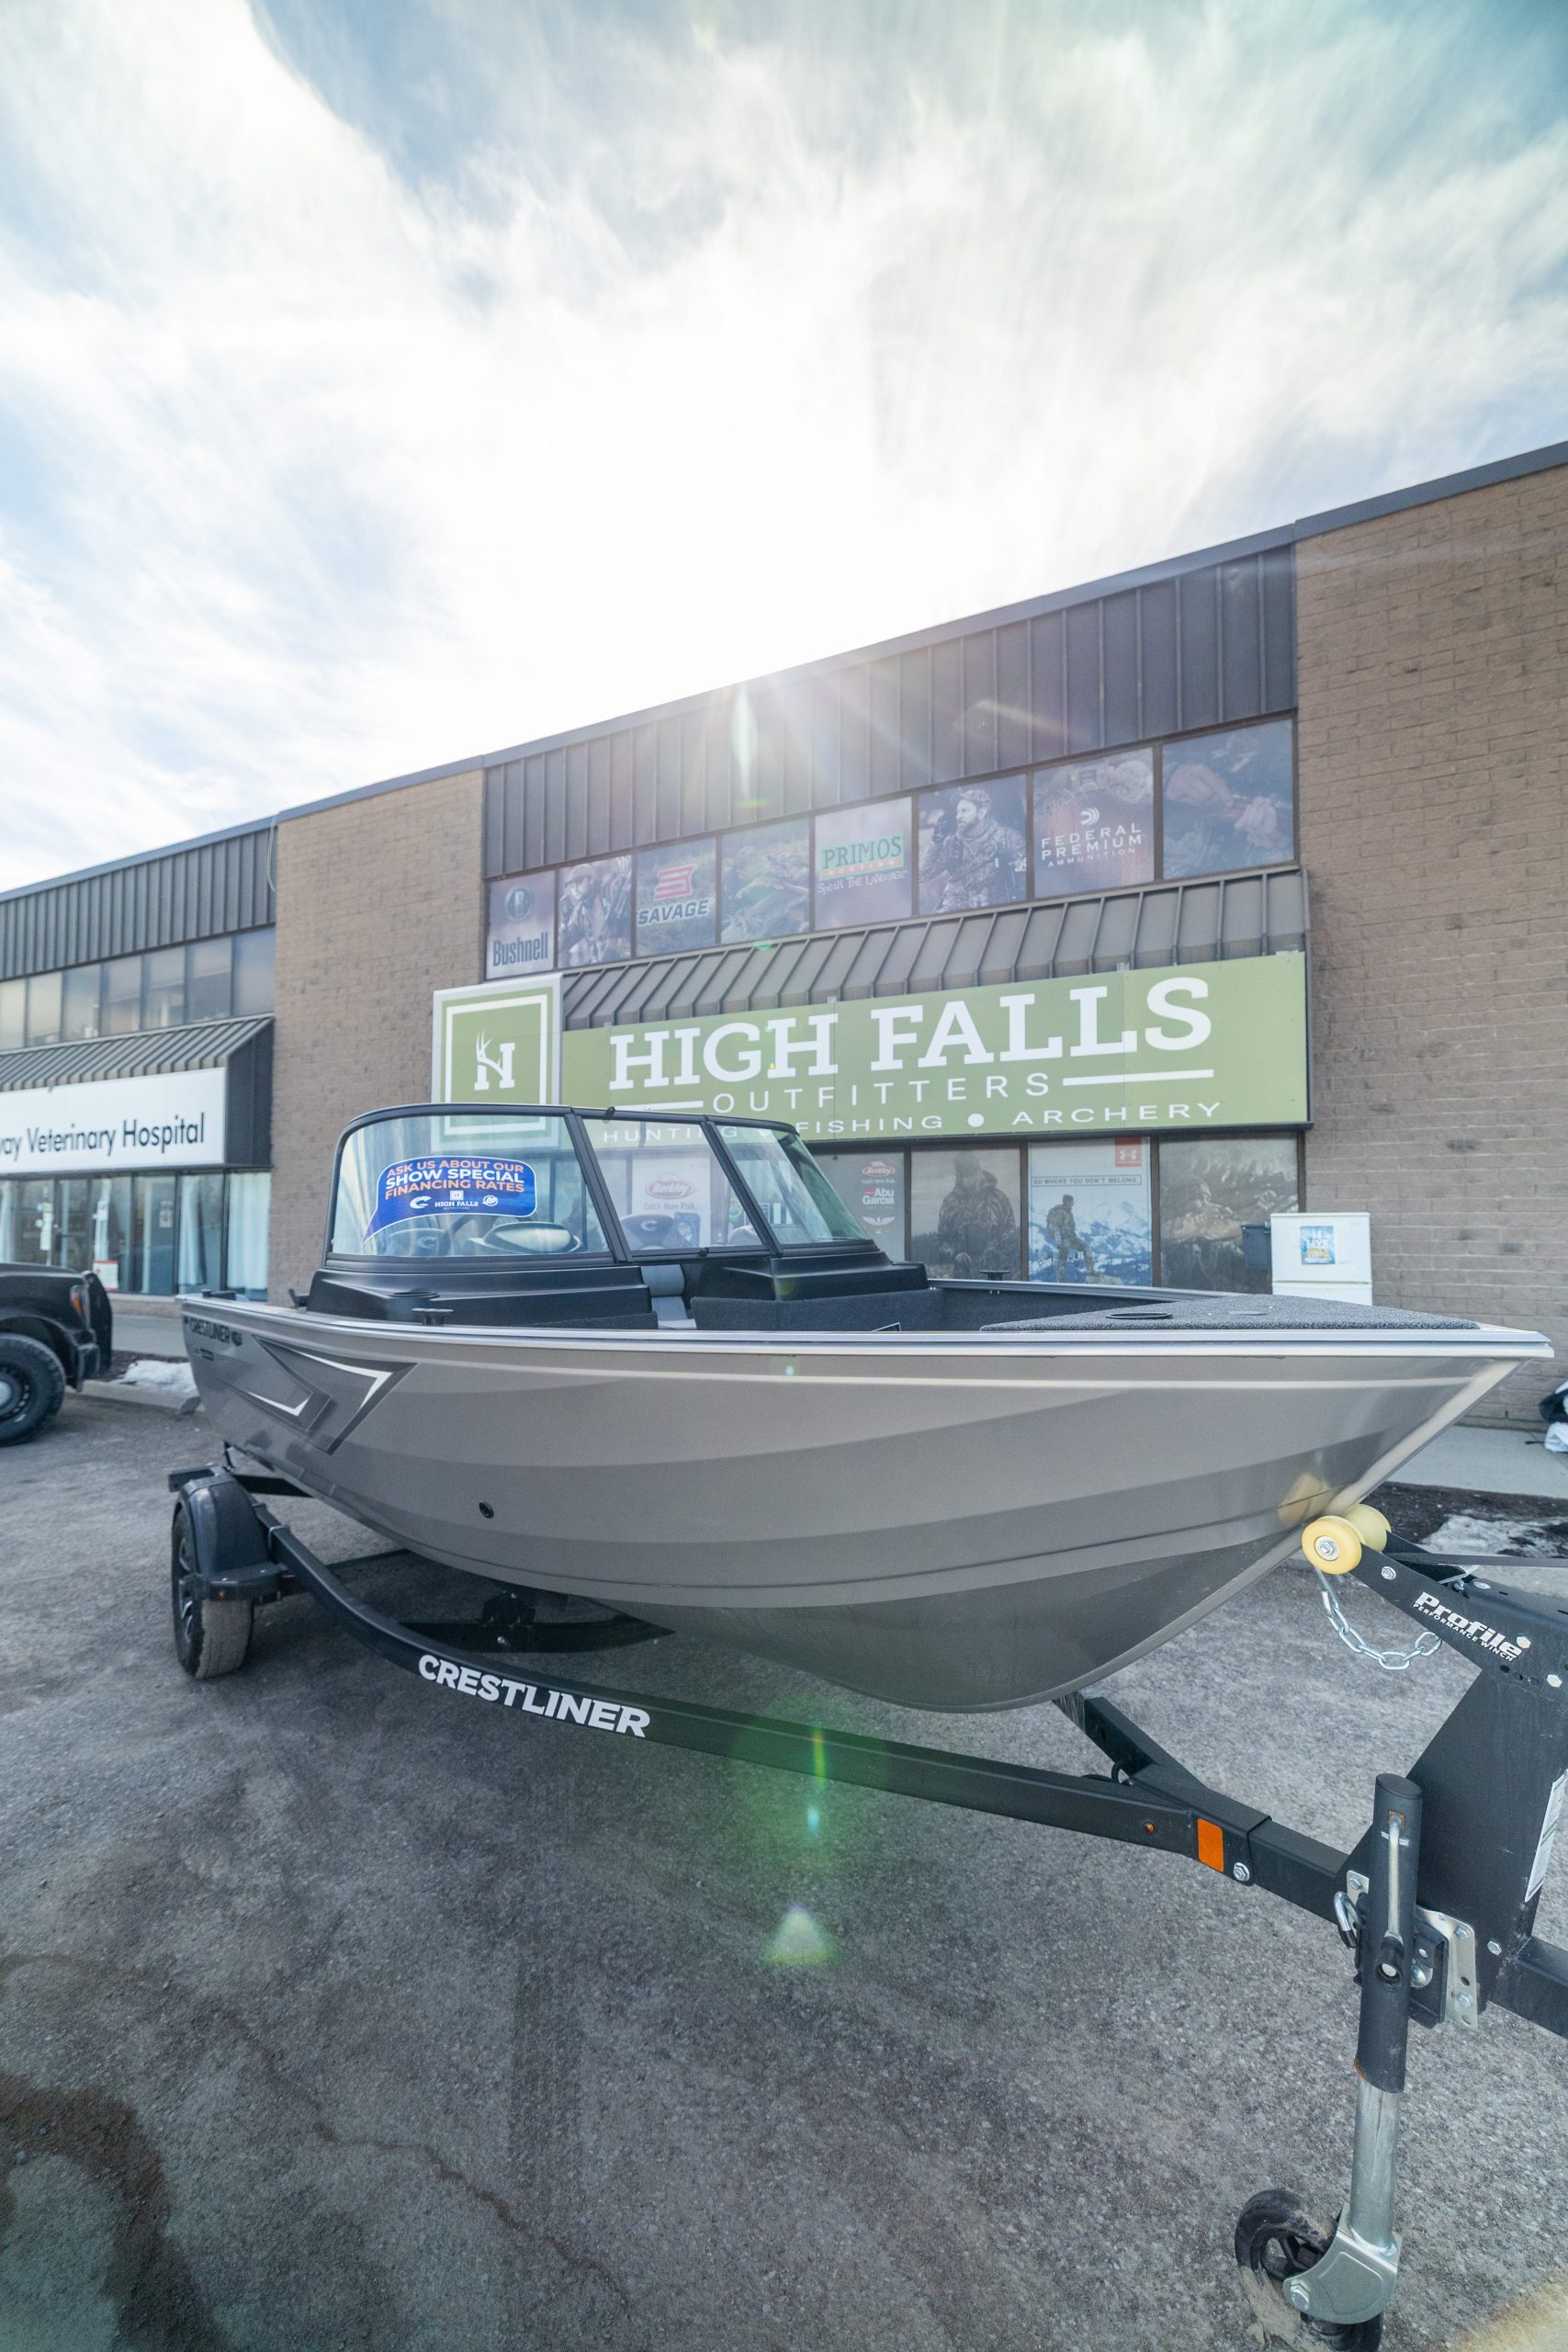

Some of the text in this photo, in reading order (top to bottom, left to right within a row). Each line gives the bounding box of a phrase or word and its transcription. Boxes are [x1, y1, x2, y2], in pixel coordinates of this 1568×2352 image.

[1041, 823, 1142, 849] FEDERAL
[1042, 834, 1142, 860] PREMIUM
[823, 836, 902, 869] PRIMOS
[1048, 848, 1135, 867] AMMUNITION
[637, 899, 709, 925] SAVAGE
[492, 932, 549, 967] Bushnell
[609, 977, 1213, 1090] HIGH FALLS
[713, 1072, 1050, 1114] OUTFITTERS
[795, 1115, 942, 1133] FISHING
[1012, 1102, 1222, 1125] ARCHERY
[0, 1112, 205, 1162] ay Veterinary Hospital
[386, 1160, 525, 1178] ASK US ABOUT OUR
[386, 1169, 525, 1190] SHOW SPECIAL
[385, 1180, 525, 1200] FINANCING RATES
[863, 1195, 895, 1204] Garcia
[874, 1187, 895, 1196] Abu
[1413, 1603, 1515, 1662] PERFORMANCE WINCH
[1415, 1591, 1523, 1658] Profile
[418, 1654, 651, 1737] CRESTLINER
